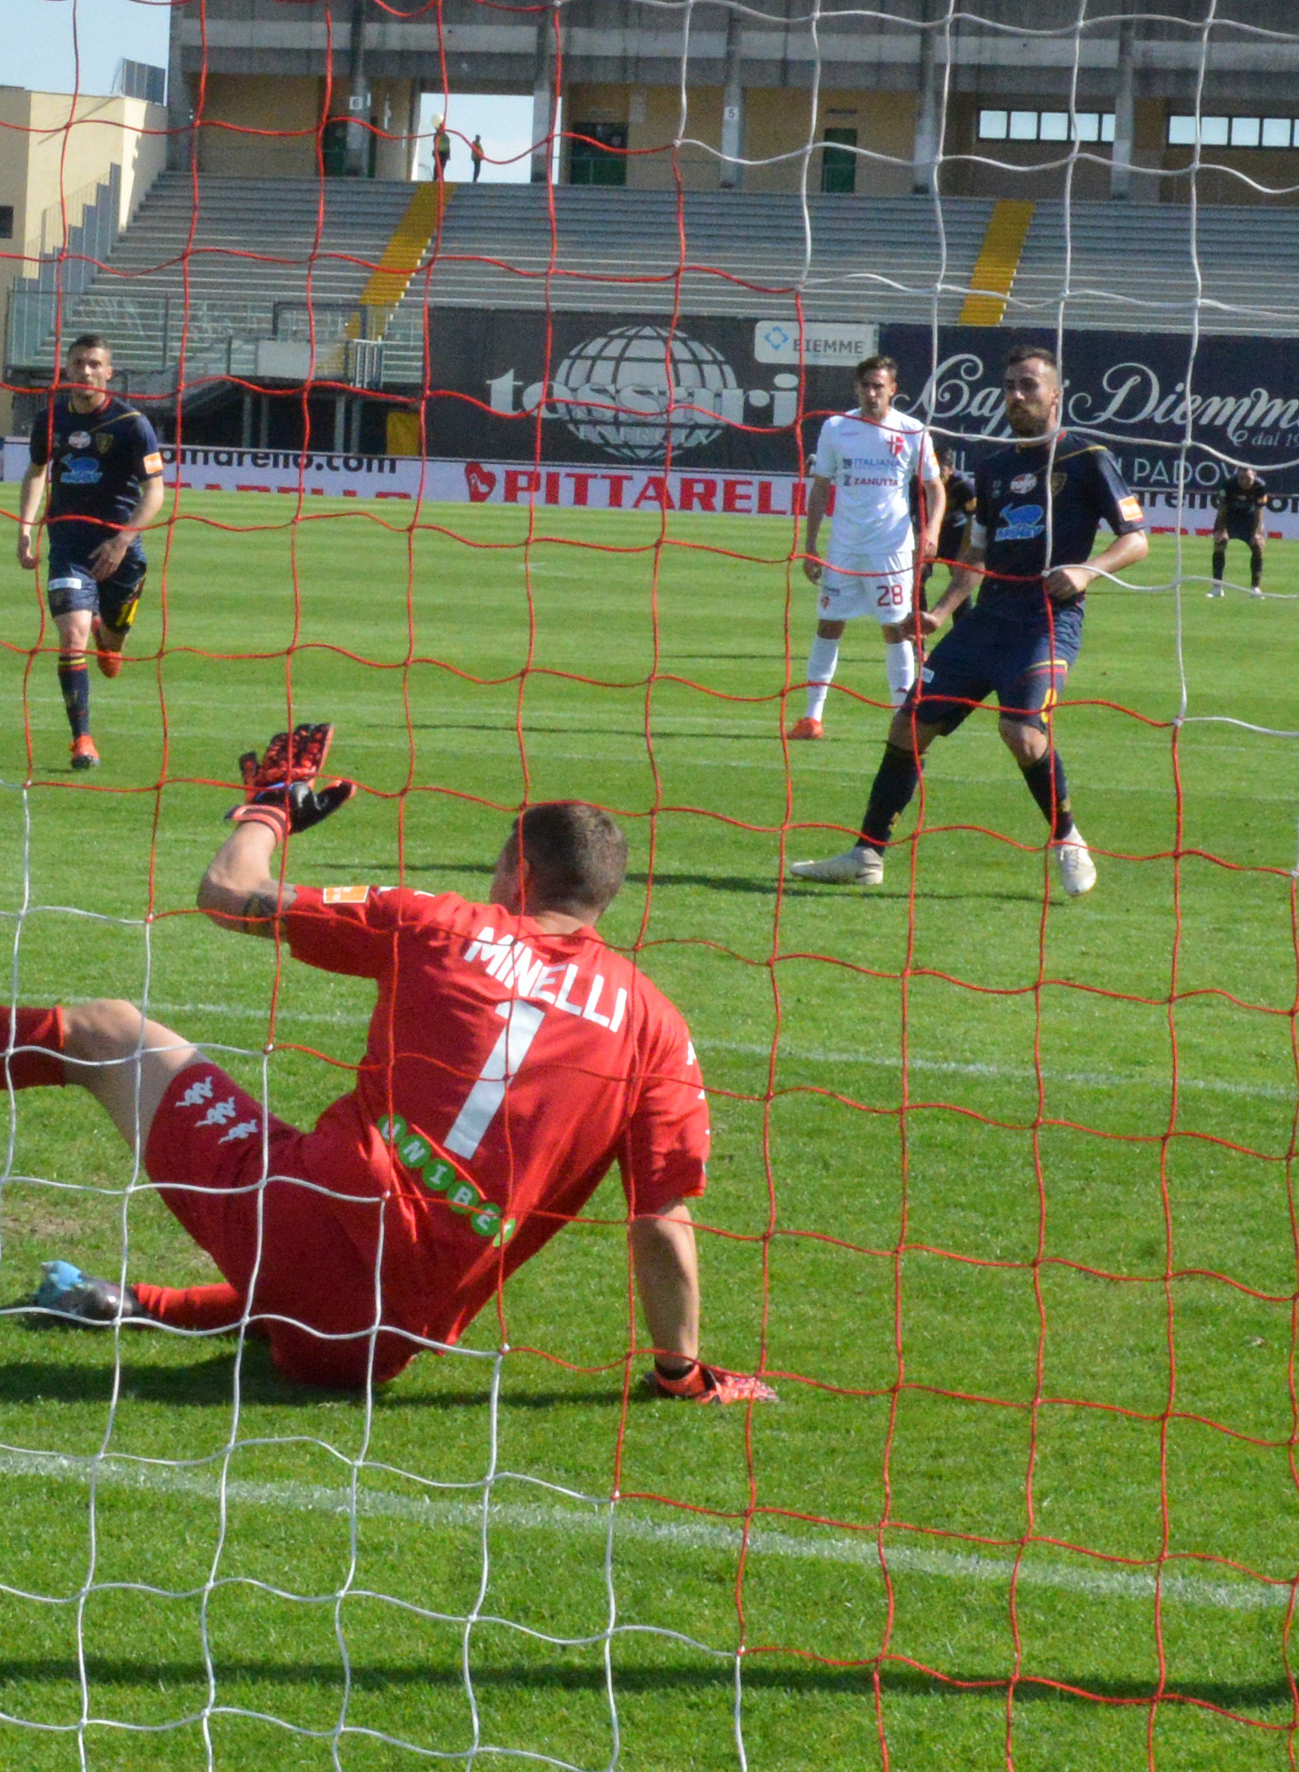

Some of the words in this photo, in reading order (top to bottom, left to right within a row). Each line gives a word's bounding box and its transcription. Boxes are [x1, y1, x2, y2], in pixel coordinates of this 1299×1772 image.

[854, 477, 899, 486] ZANUTTA
[1133, 456, 1239, 487] PADOV
[876, 584, 904, 608] 28
[463, 925, 628, 1034] MINELLI
[443, 999, 546, 1160] 1
[380, 1117, 514, 1236] UNIBE
